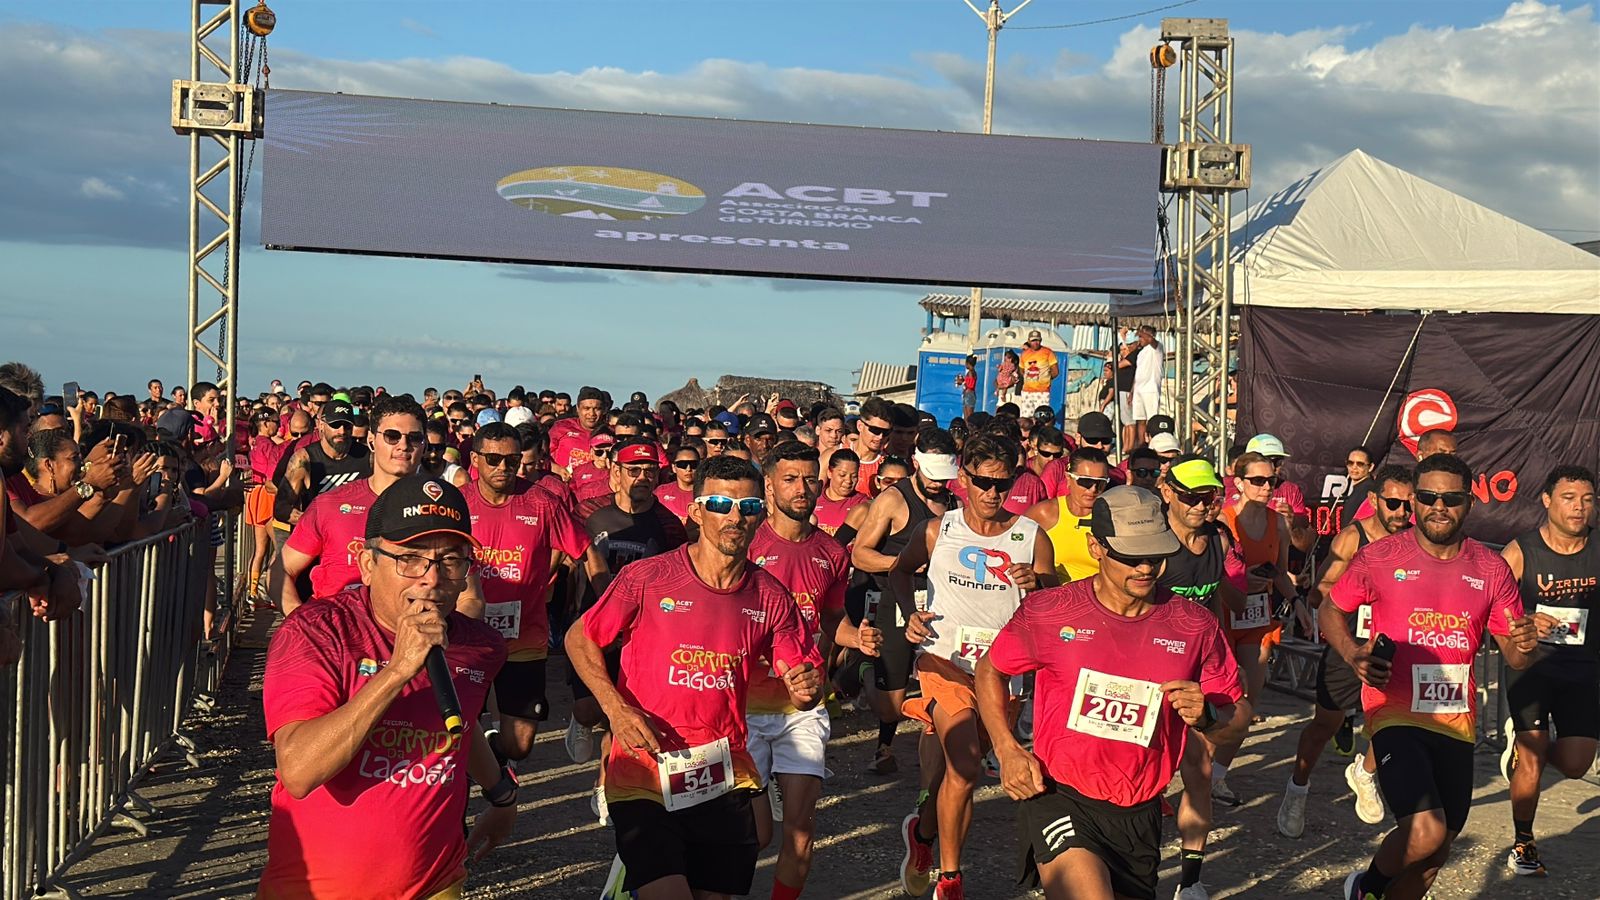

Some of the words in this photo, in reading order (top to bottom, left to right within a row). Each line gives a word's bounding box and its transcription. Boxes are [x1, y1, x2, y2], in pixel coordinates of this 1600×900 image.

[721, 182, 949, 208] ACBT
[719, 199, 869, 213] Associação
[719, 207, 807, 219] COSTA
[813, 212, 922, 225] BRANCA
[593, 229, 850, 251] apresenta
[403, 504, 461, 521] RNCRONO
[948, 575, 1007, 591] Runners
[1462, 575, 1485, 585] POWER
[1537, 573, 1597, 591] VIRTUS
[741, 607, 766, 618] POWER
[1076, 628, 1096, 636] ACBT
[1153, 637, 1186, 648] POWER
[1166, 646, 1185, 655] ADE
[964, 643, 991, 661] 27
[1424, 683, 1459, 701] 407
[1086, 697, 1140, 725] 205
[685, 766, 713, 792] 54
